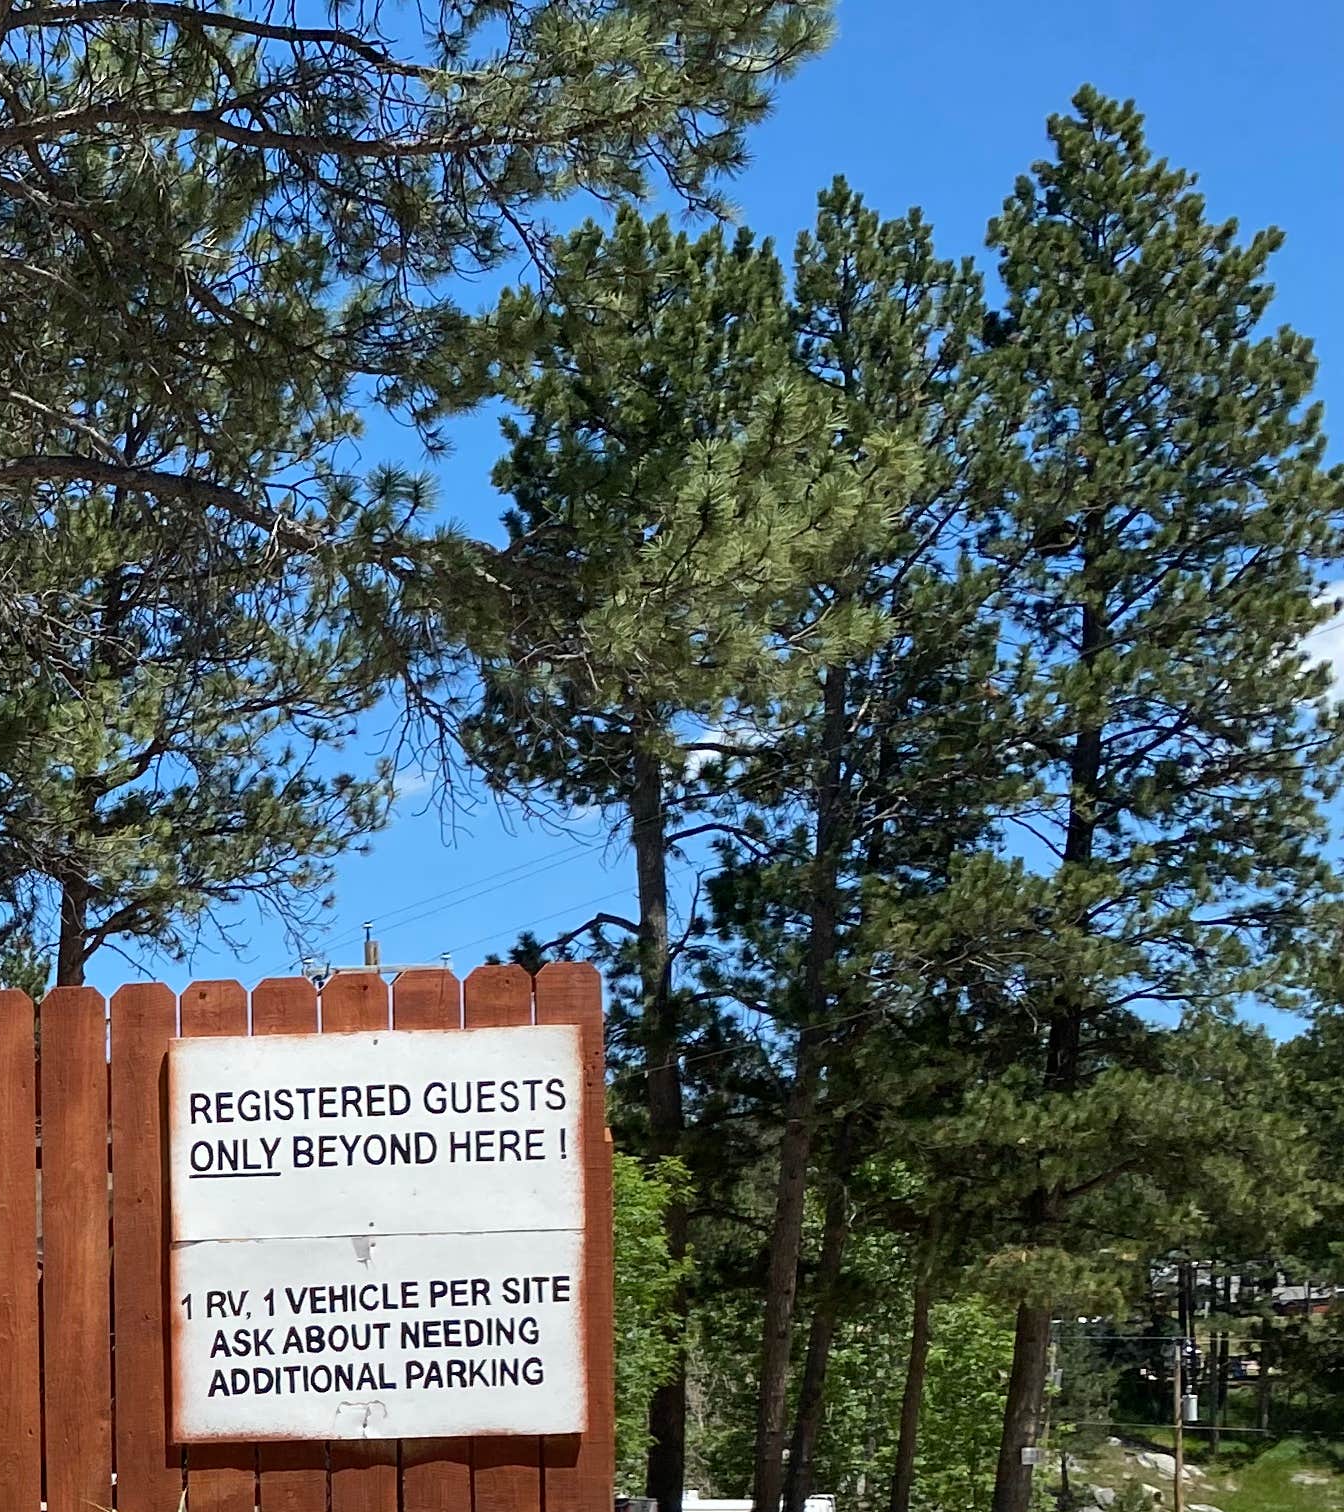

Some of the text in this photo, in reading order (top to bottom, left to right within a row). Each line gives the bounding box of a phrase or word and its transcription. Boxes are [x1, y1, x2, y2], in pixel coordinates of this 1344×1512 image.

[189, 1078, 567, 1125] REGISTERED GUESTS
[188, 1137, 282, 1173] ONLY
[293, 1131, 438, 1169] BEYOND
[180, 1275, 571, 1320] 1 RV, 1 VEHICLE PER SITE
[209, 1316, 541, 1359] ASK ABOUT NEEDING
[207, 1356, 545, 1398] ADDITIONAL PARKING
